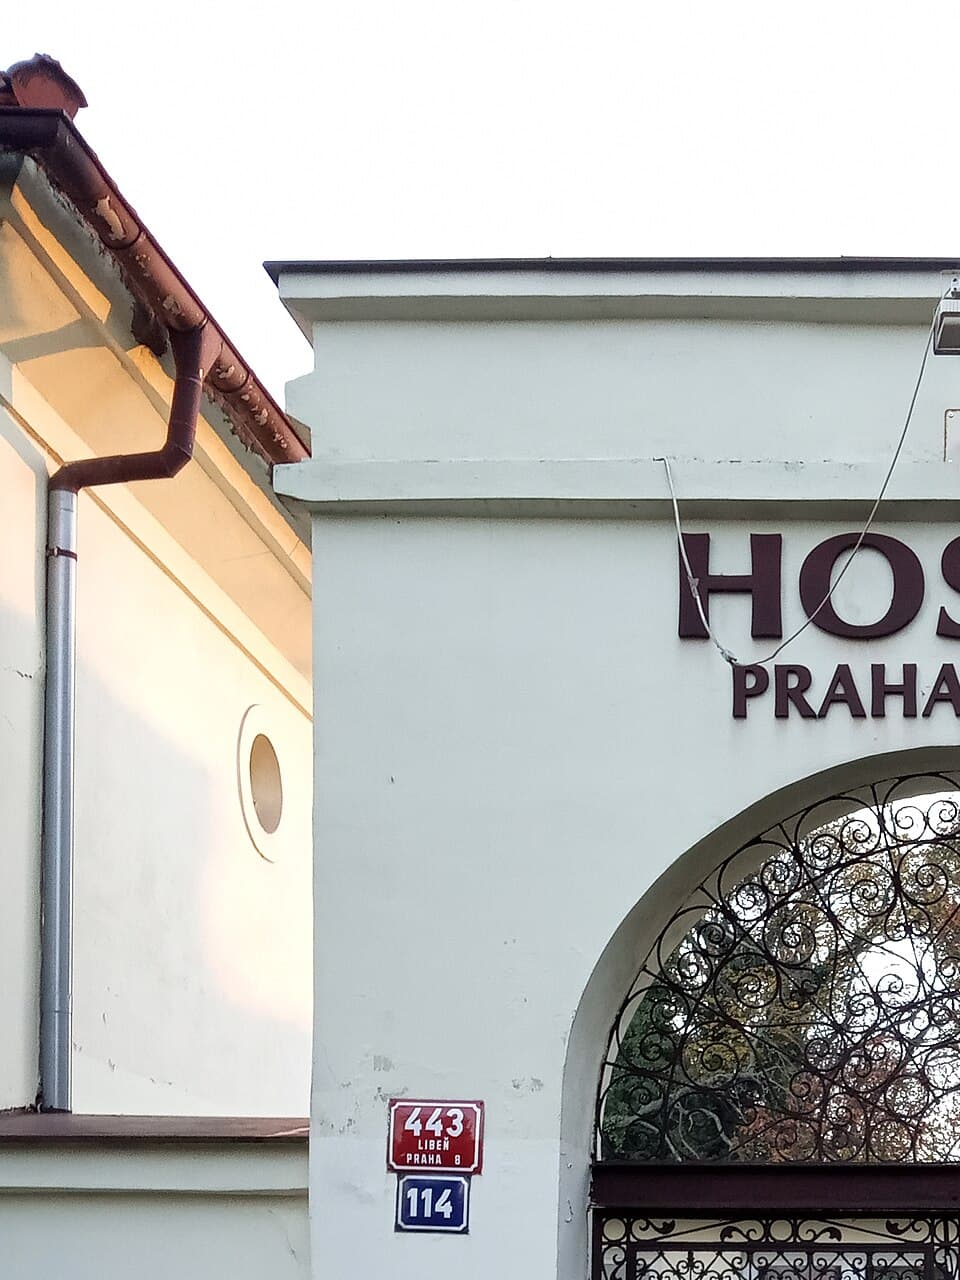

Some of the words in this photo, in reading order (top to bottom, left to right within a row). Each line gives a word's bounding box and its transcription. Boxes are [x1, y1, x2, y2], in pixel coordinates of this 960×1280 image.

[404, 1107, 464, 1137] 443
[418, 1137, 450, 1151] LIBEŇ
[406, 1153, 442, 1165] PRAHA
[454, 1154, 461, 1166] 8
[406, 1188, 453, 1219] 114
